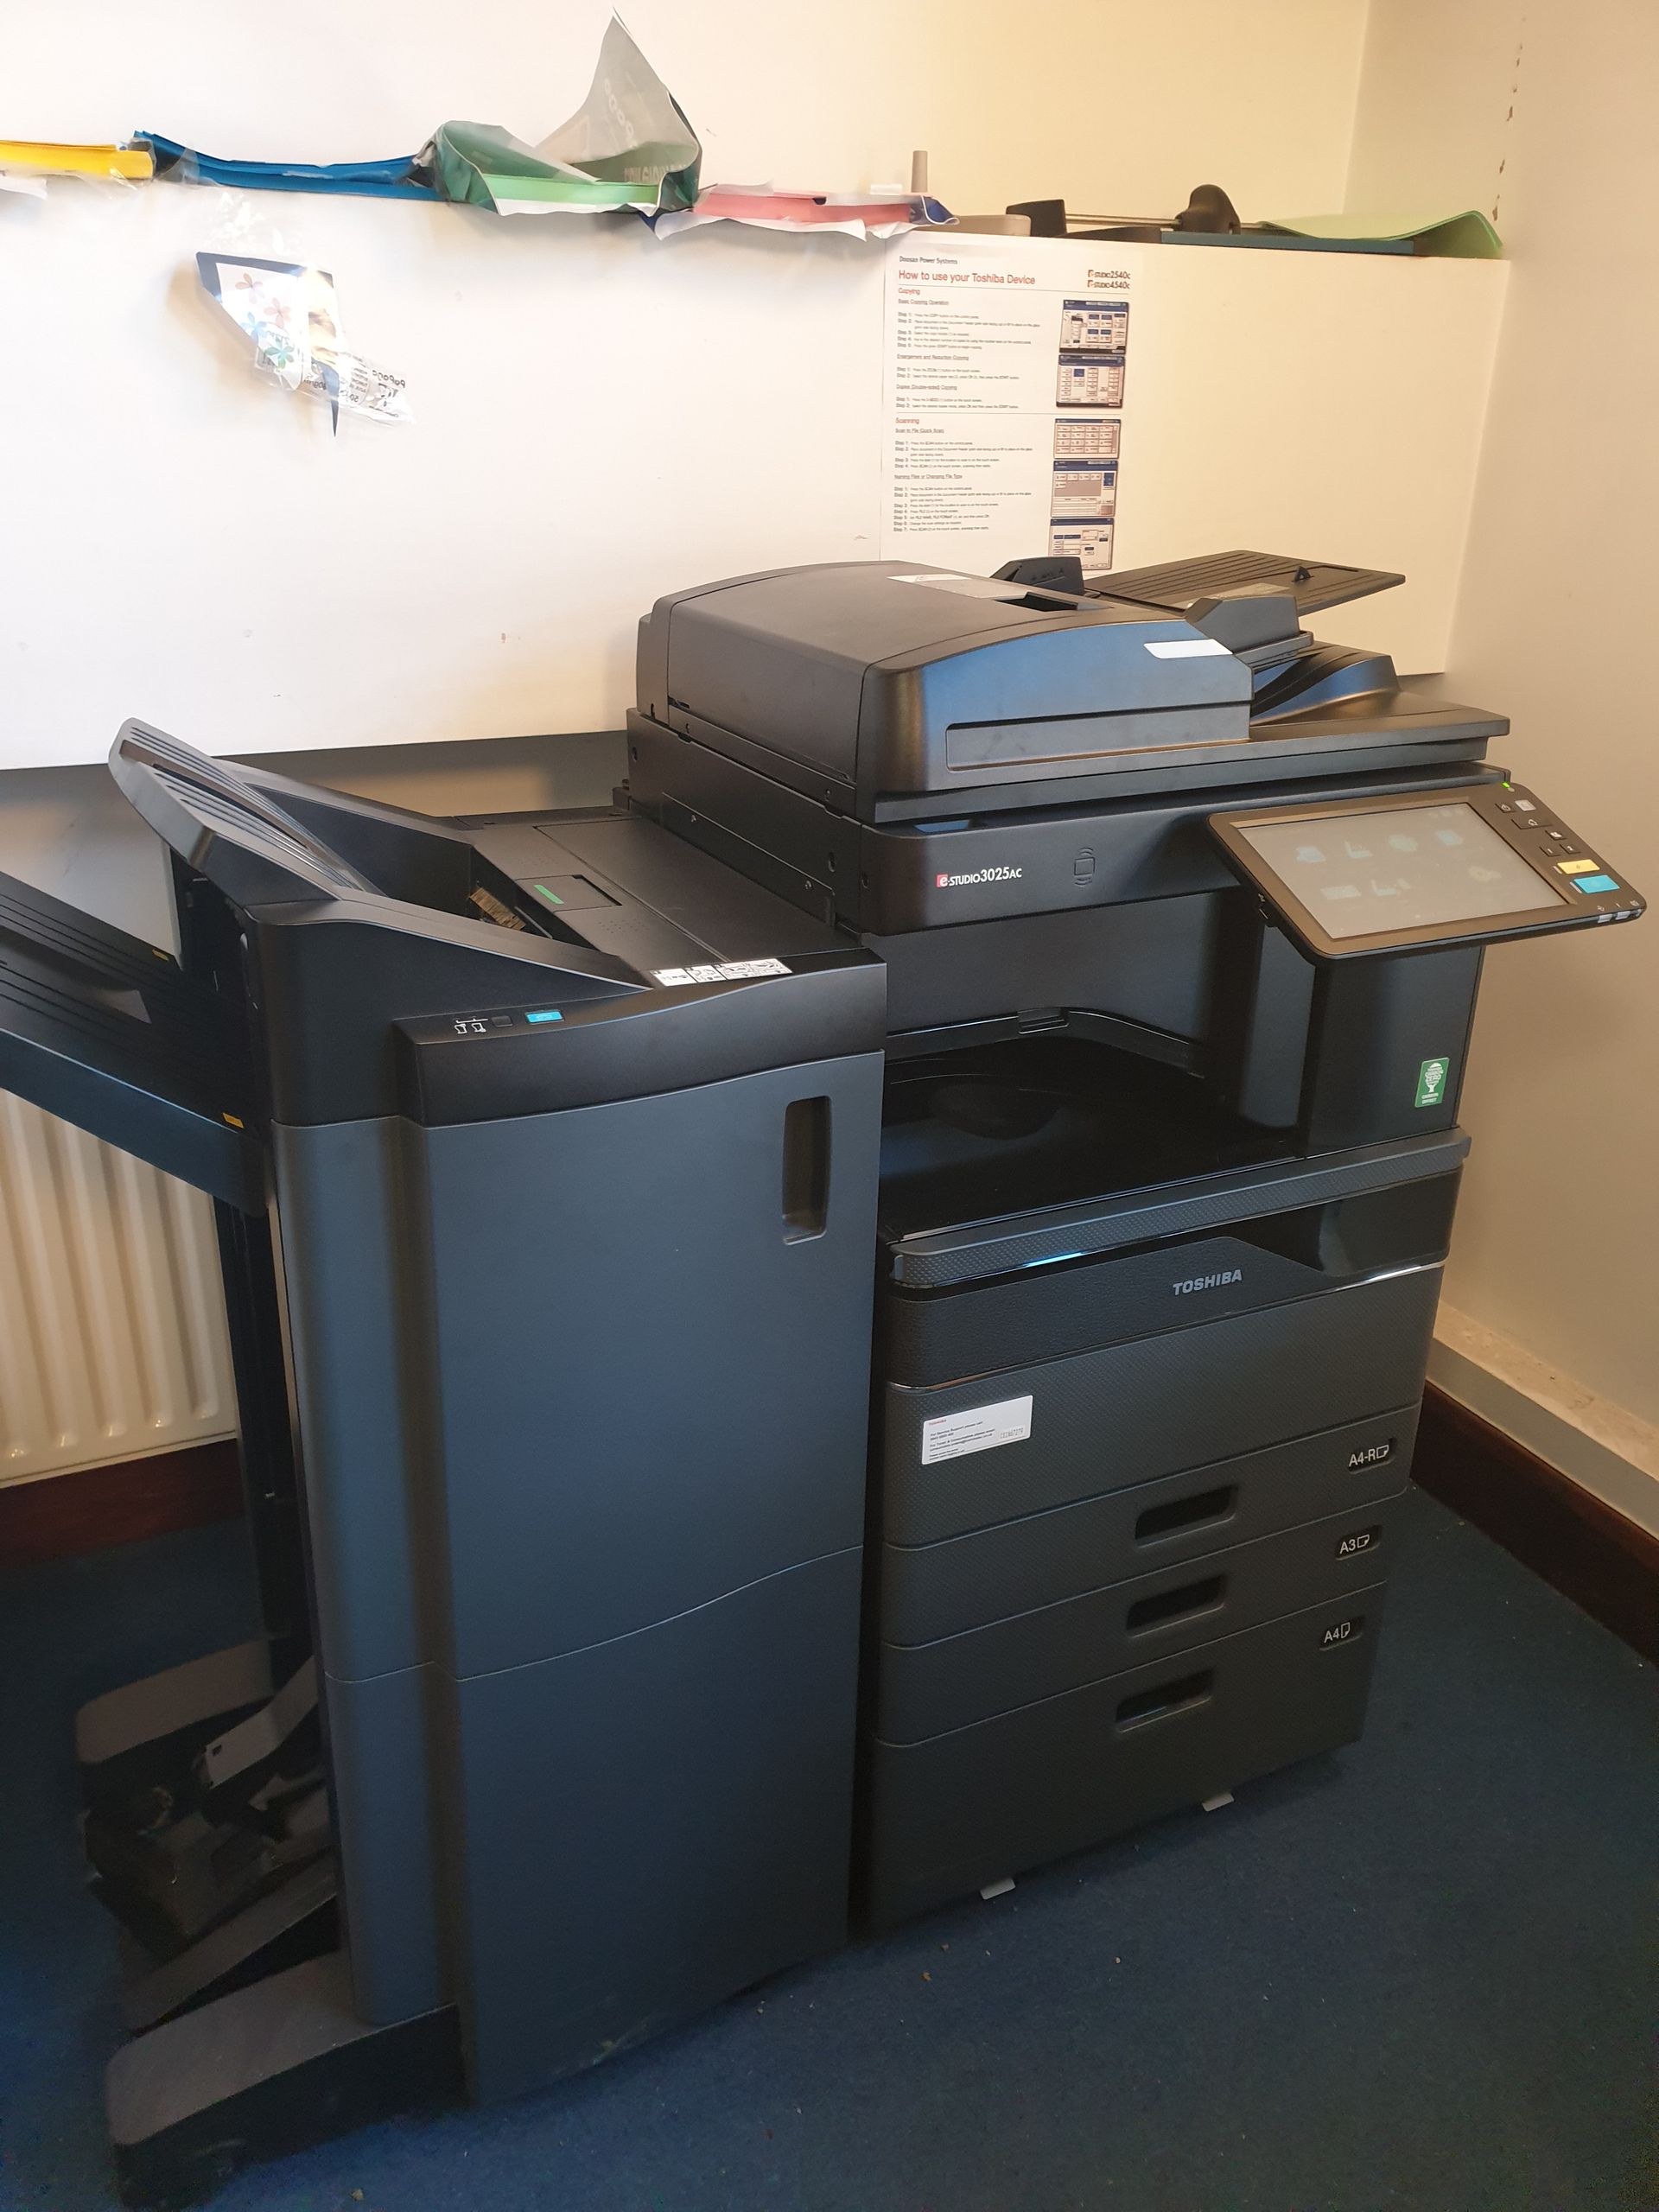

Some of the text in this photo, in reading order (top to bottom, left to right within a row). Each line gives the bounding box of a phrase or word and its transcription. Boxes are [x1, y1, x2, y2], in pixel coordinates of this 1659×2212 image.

[899, 270, 1036, 284] How to use your Toshiba Device
[1173, 1269, 1243, 1296] TOSHIBA
[1348, 1448, 1376, 1467] A4-R
[1339, 1538, 1356, 1554] A3
[1324, 1628, 1340, 1643] A4
